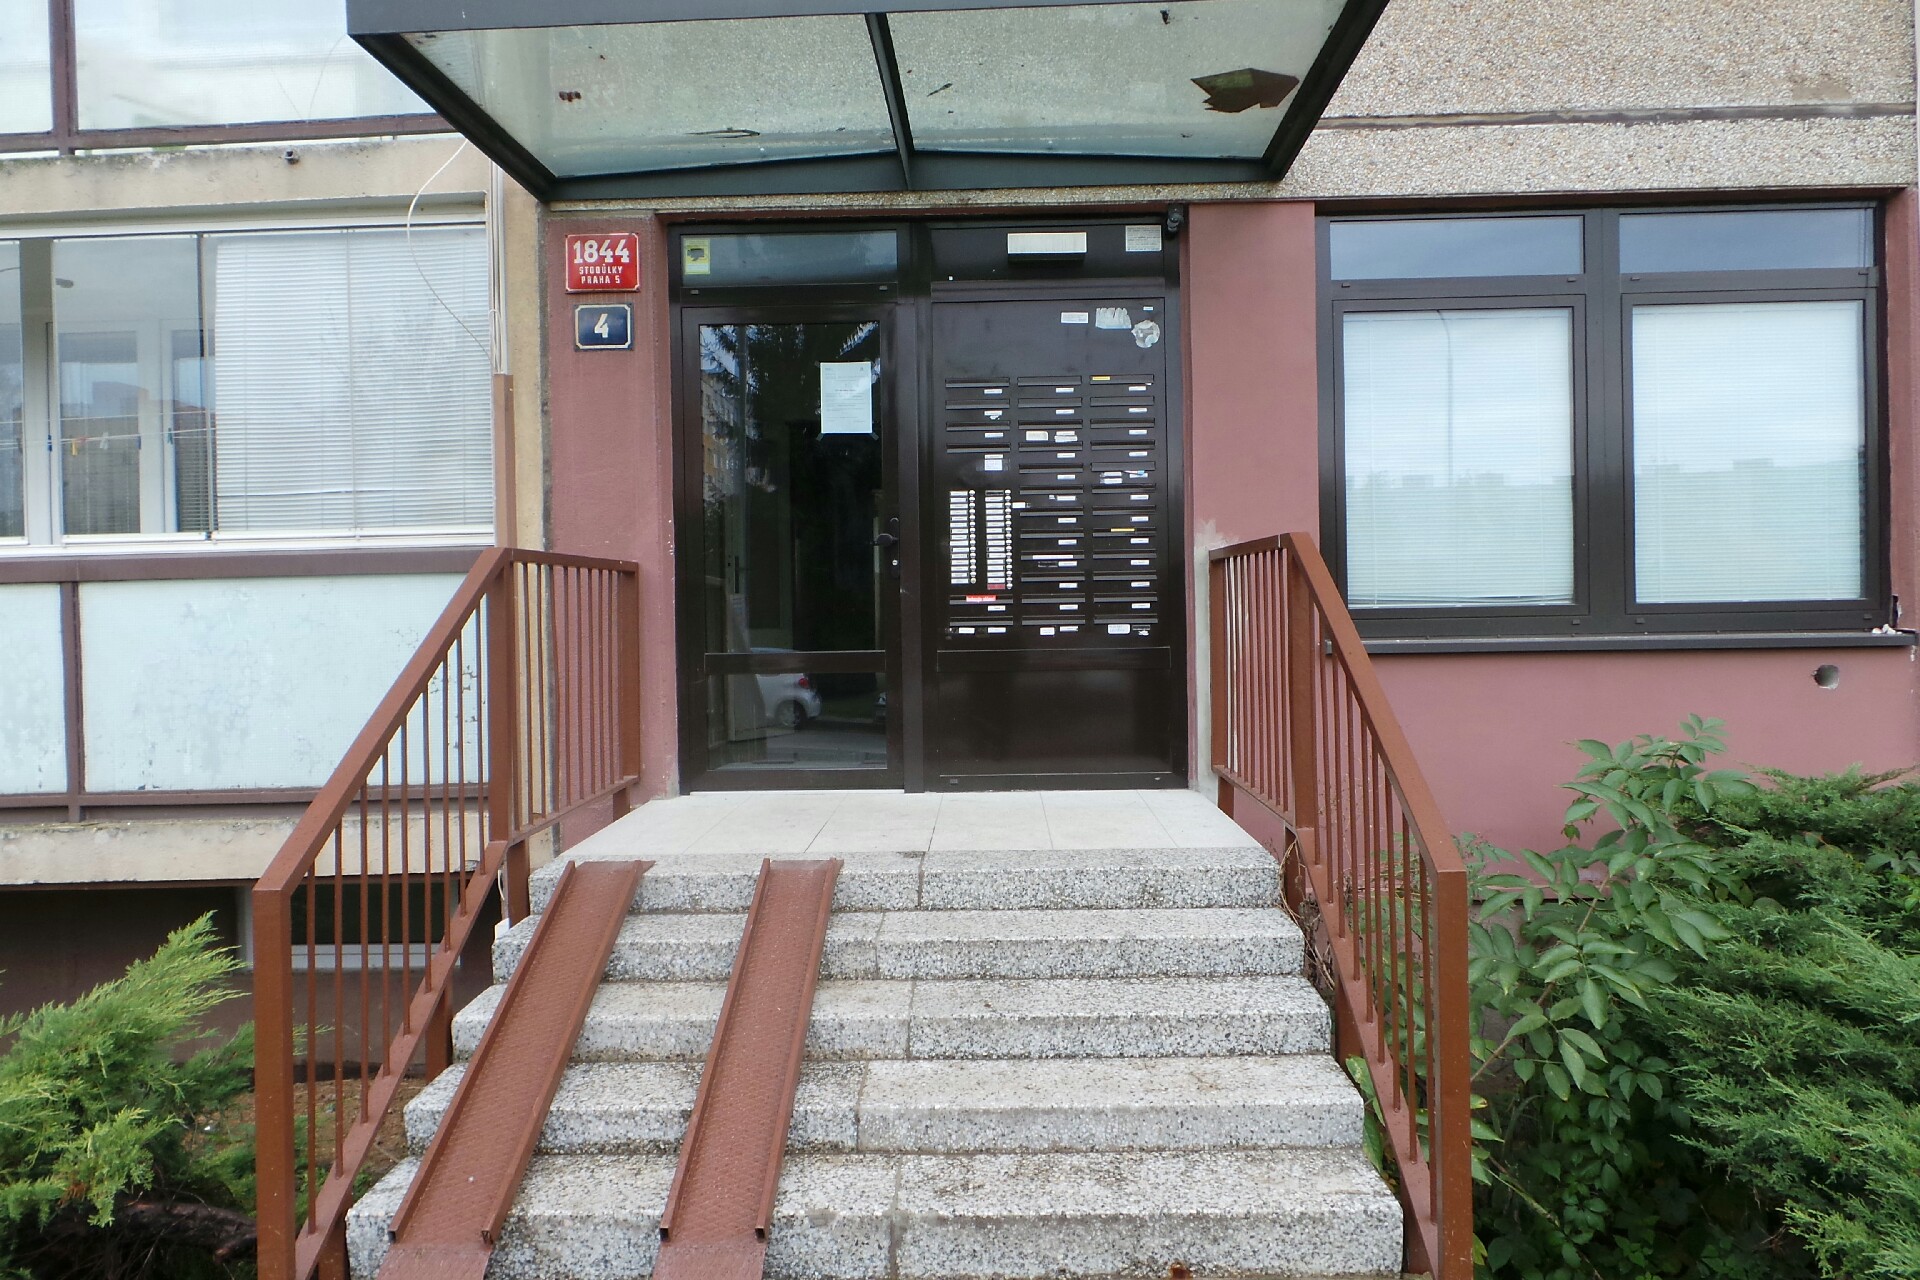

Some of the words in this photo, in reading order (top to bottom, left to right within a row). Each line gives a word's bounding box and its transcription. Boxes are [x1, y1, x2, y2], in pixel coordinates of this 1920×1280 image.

[573, 240, 629, 263] 1844
[579, 264, 622, 274] STODŮLKY
[581, 275, 611, 284] PRAHA
[615, 275, 620, 284] 5
[594, 313, 608, 338] 4
